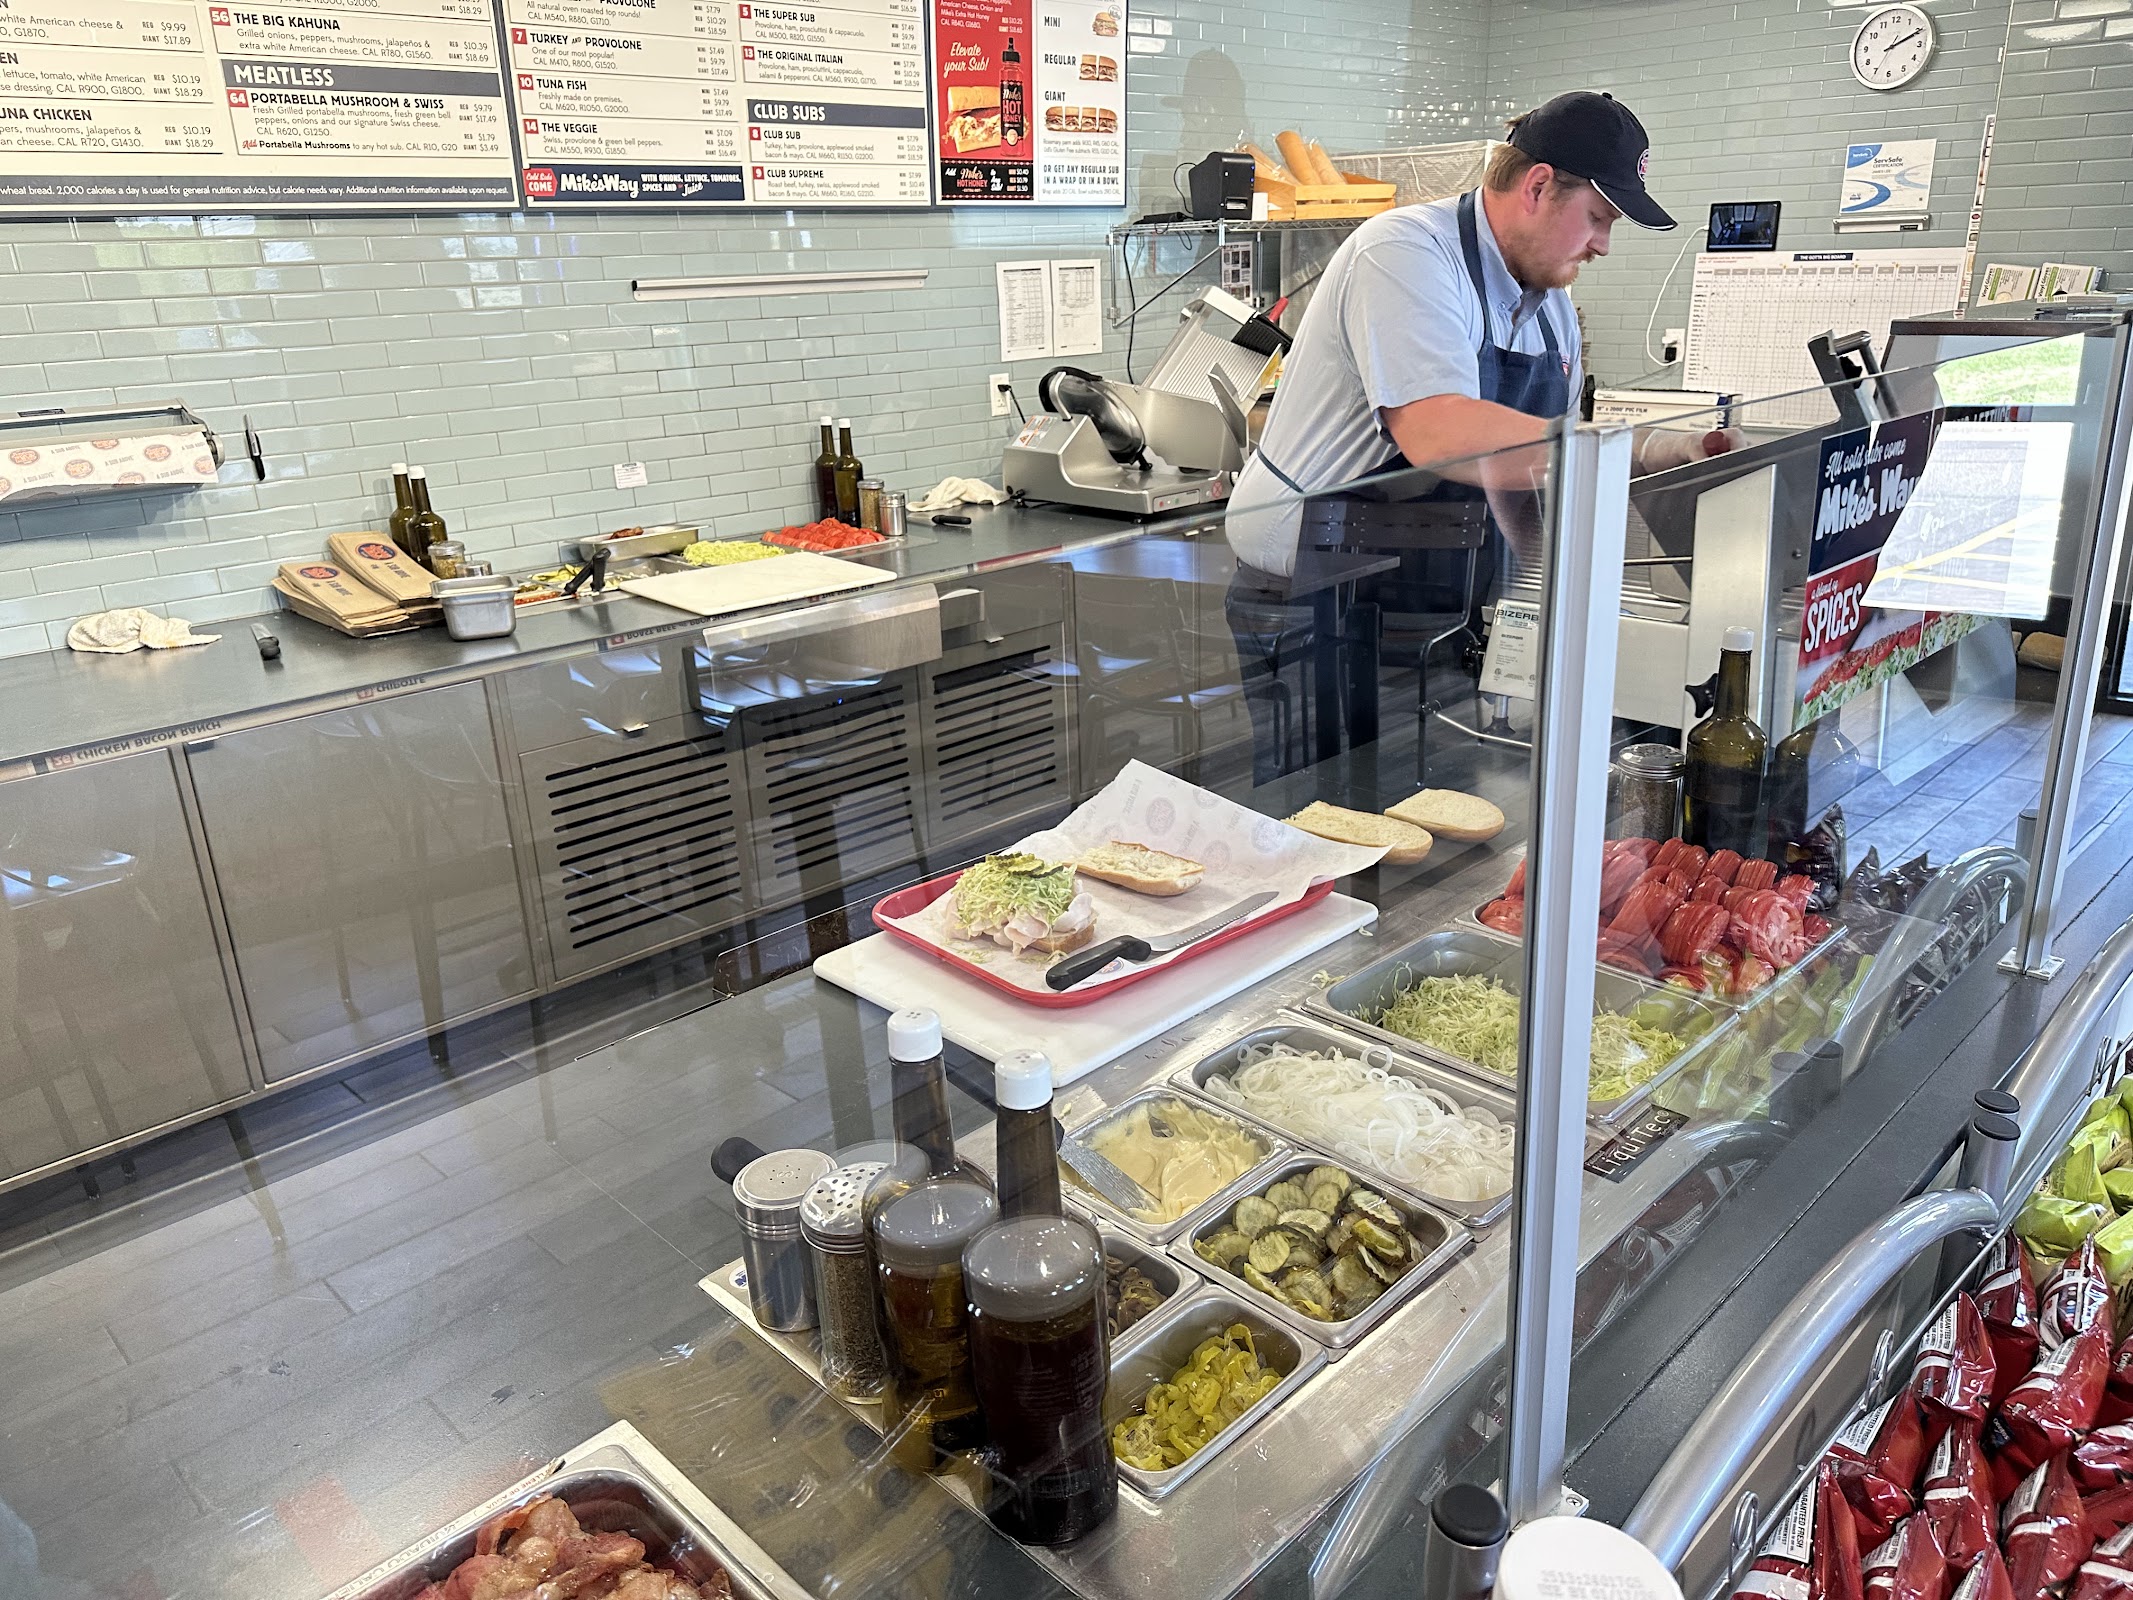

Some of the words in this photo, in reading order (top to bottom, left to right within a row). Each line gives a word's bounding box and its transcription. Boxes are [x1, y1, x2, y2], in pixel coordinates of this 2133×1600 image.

[211, 10, 229, 22] 56
[234, 12, 259, 24] THE
[262, 15, 284, 26] BIG
[288, 16, 340, 30] KAHUNA
[742, 7, 748, 16] 5
[754, 8, 770, 18] THE
[772, 10, 798, 20] SUPER
[800, 13, 816, 22] SUB
[1892, 16, 1902, 24] 12
[161, 22, 186, 32] $9.99
[1044, 16, 1060, 28] MINI
[516, 31, 522, 42] 7
[530, 32, 568, 45] TURKEY
[585, 36, 642, 50] PROVOLONE
[950, 42, 982, 56] Elevate
[744, 48, 754, 58] 13
[758, 50, 773, 60] THE
[776, 52, 812, 62] ORIGINAL
[815, 54, 843, 64] ITALIAN
[1044, 54, 1076, 66] REGULAR
[943, 60, 967, 78] your
[968, 56, 990, 72] Sub!
[1900, 64, 1906, 72] 5
[233, 64, 335, 87] MEATLESS
[520, 77, 532, 88] 10
[536, 78, 564, 90] TUNA
[566, 80, 588, 90] FISH
[229, 92, 246, 104] 64
[250, 92, 328, 106] PORTABELLA
[331, 95, 400, 108] MUSHROOM
[404, 98, 411, 108] &
[414, 98, 444, 109] SWISS
[1003, 88, 1022, 100] Mike's
[1044, 90, 1066, 102] GIANT
[754, 104, 788, 120] CLUB
[792, 105, 826, 122] SUBS
[1002, 100, 1021, 114] HOT
[33, 108, 93, 120] CHICKEN
[1002, 114, 1022, 122] HONEY
[525, 121, 538, 132] 14
[541, 122, 560, 132] THE
[564, 123, 598, 134] VEGGIE
[752, 129, 759, 138] 8
[764, 130, 783, 139] CLUB
[786, 130, 801, 140] SUB
[259, 140, 302, 149] Portabella
[304, 142, 350, 150] Mushrooms
[755, 168, 762, 178] 9
[767, 169, 786, 178] CLUB
[789, 169, 824, 178] SUPREME
[1044, 164, 1052, 172] OR
[1054, 164, 1064, 172] GET
[1067, 165, 1078, 173] ANY
[1081, 166, 1106, 174] REGULAR
[1108, 166, 1120, 174] SUB
[641, 174, 658, 182] WITH
[659, 174, 684, 182] ONIONS,
[1044, 176, 1050, 184] IN
[1052, 176, 1056, 184] A
[1058, 176, 1076, 184] WRAP
[1078, 176, 1086, 184] OR
[1088, 176, 1094, 184] IN
[1096, 176, 1100, 184] A
[1102, 176, 1119, 185] BOWL
[0, 186, 26, 195] wheat
[28, 186, 55, 195] bread.
[56, 186, 84, 196] 2,000
[86, 186, 116, 195] calories
[126, 186, 140, 198] day
[141, 186, 148, 195] is
[150, 186, 169, 195] used
[170, 185, 180, 194] for
[182, 186, 210, 198] general
[212, 186, 242, 195] nutrition
[242, 186, 268, 196] advice,
[270, 186, 281, 194] but
[282, 186, 306, 194] calorie
[306, 186, 328, 194] needs
[328, 187, 345, 196] vary.
[346, 186, 378, 194] Additional
[379, 186, 405, 195] nutrition
[406, 186, 440, 195] information
[442, 186, 468, 195] available
[469, 188, 484, 196] upon
[528, 182, 553, 192] COME
[642, 183, 662, 192] SPICES
[664, 183, 676, 192] AND
[682, 182, 704, 196] Juice
[1985, 268, 1994, 286] Gloves
[2042, 266, 2050, 286] Gloves
[1824, 450, 1844, 484] All
[1843, 444, 1864, 475] cold
[1864, 440, 1882, 469] subs
[1884, 438, 1907, 462] come
[1815, 474, 1878, 542] Mike's
[1496, 609, 1540, 622] BIZERB
[1804, 582, 1863, 652] SPICES
[1796, 1526, 1806, 1548] FRESH
